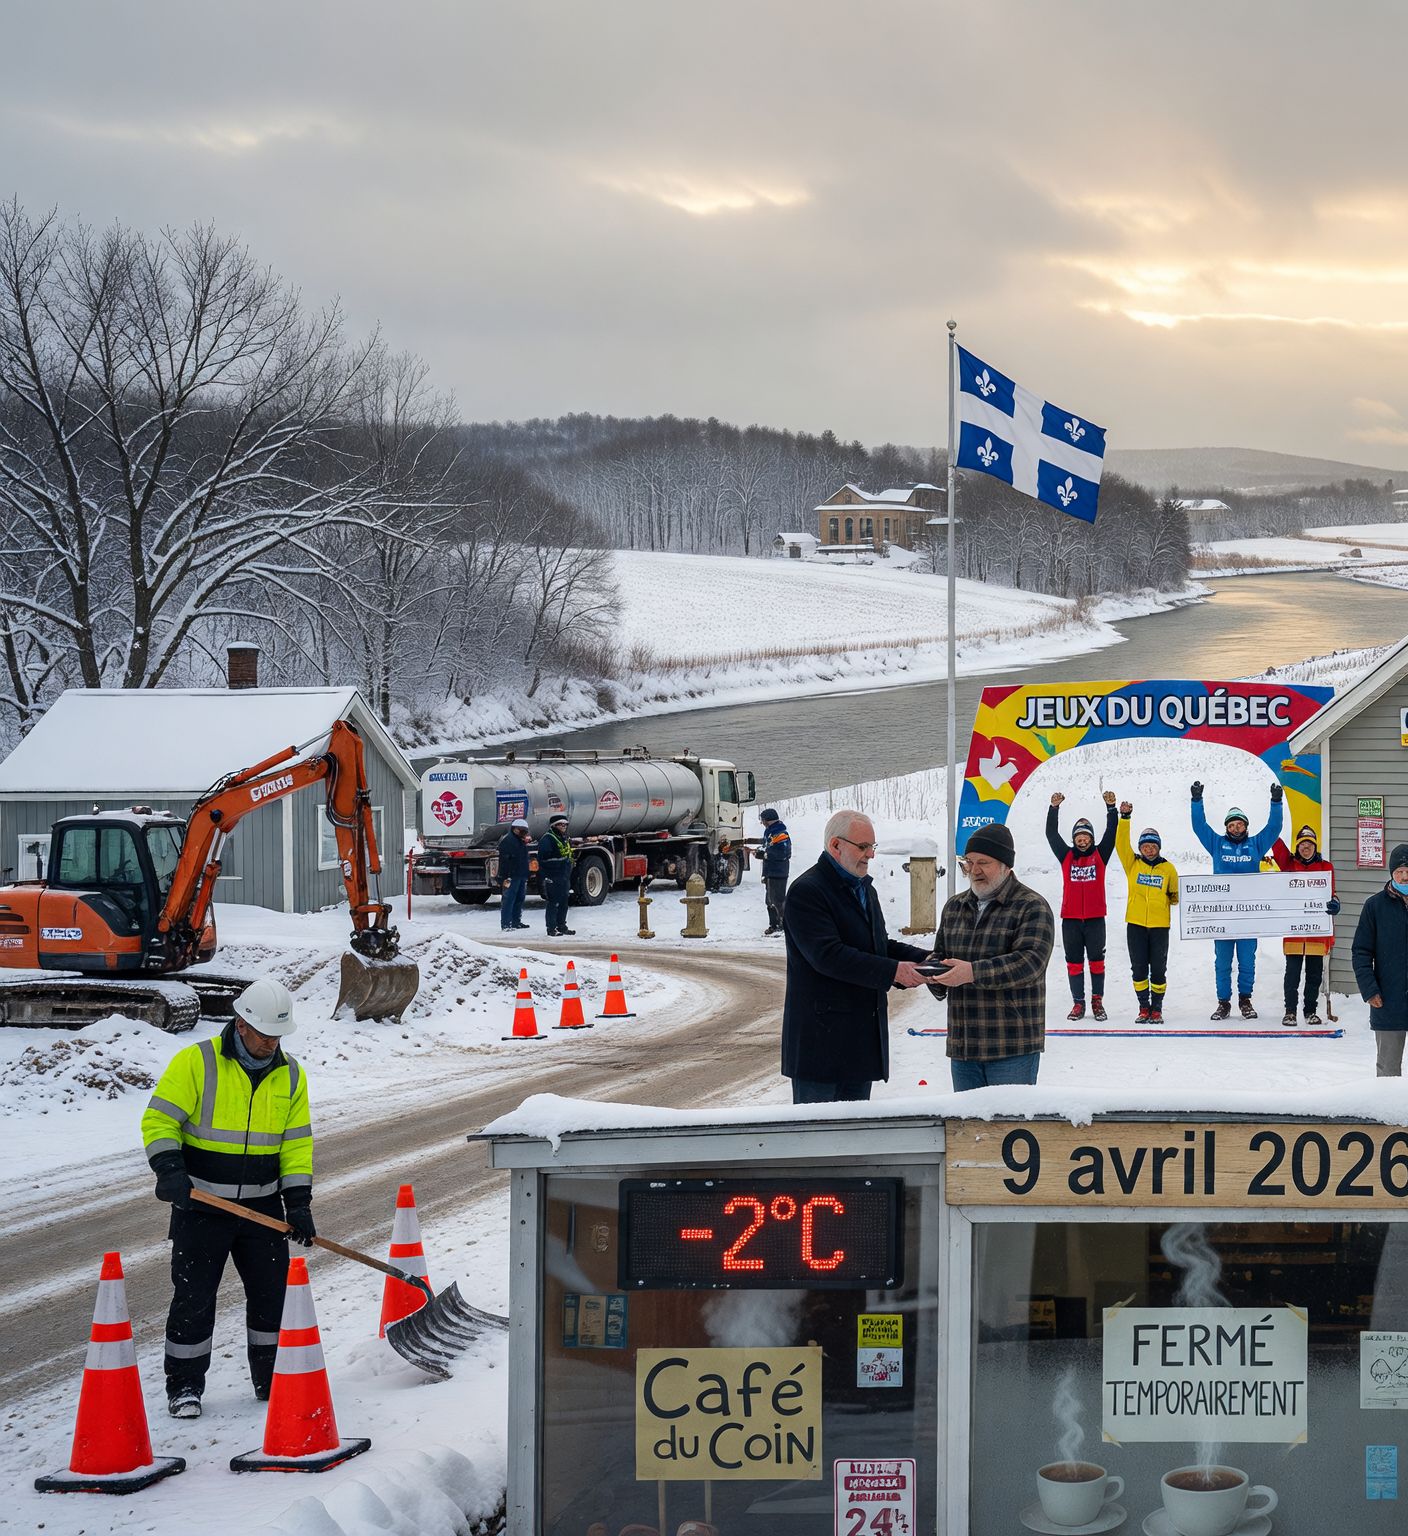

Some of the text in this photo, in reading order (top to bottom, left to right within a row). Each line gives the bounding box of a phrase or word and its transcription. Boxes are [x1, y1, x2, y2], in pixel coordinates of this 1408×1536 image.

[1017, 689, 1290, 730] JEUX DU QUÉBEC
[1002, 1129, 1040, 1195] 9
[1068, 1131, 1215, 1195] avril
[681, 1196, 844, 1270] -2°C
[1133, 1314, 1274, 1366] FERMÉ
[644, 1358, 805, 1419] Café
[1106, 1381, 1304, 1416] TEMPORAIREMENT
[654, 1425, 698, 1460] du
